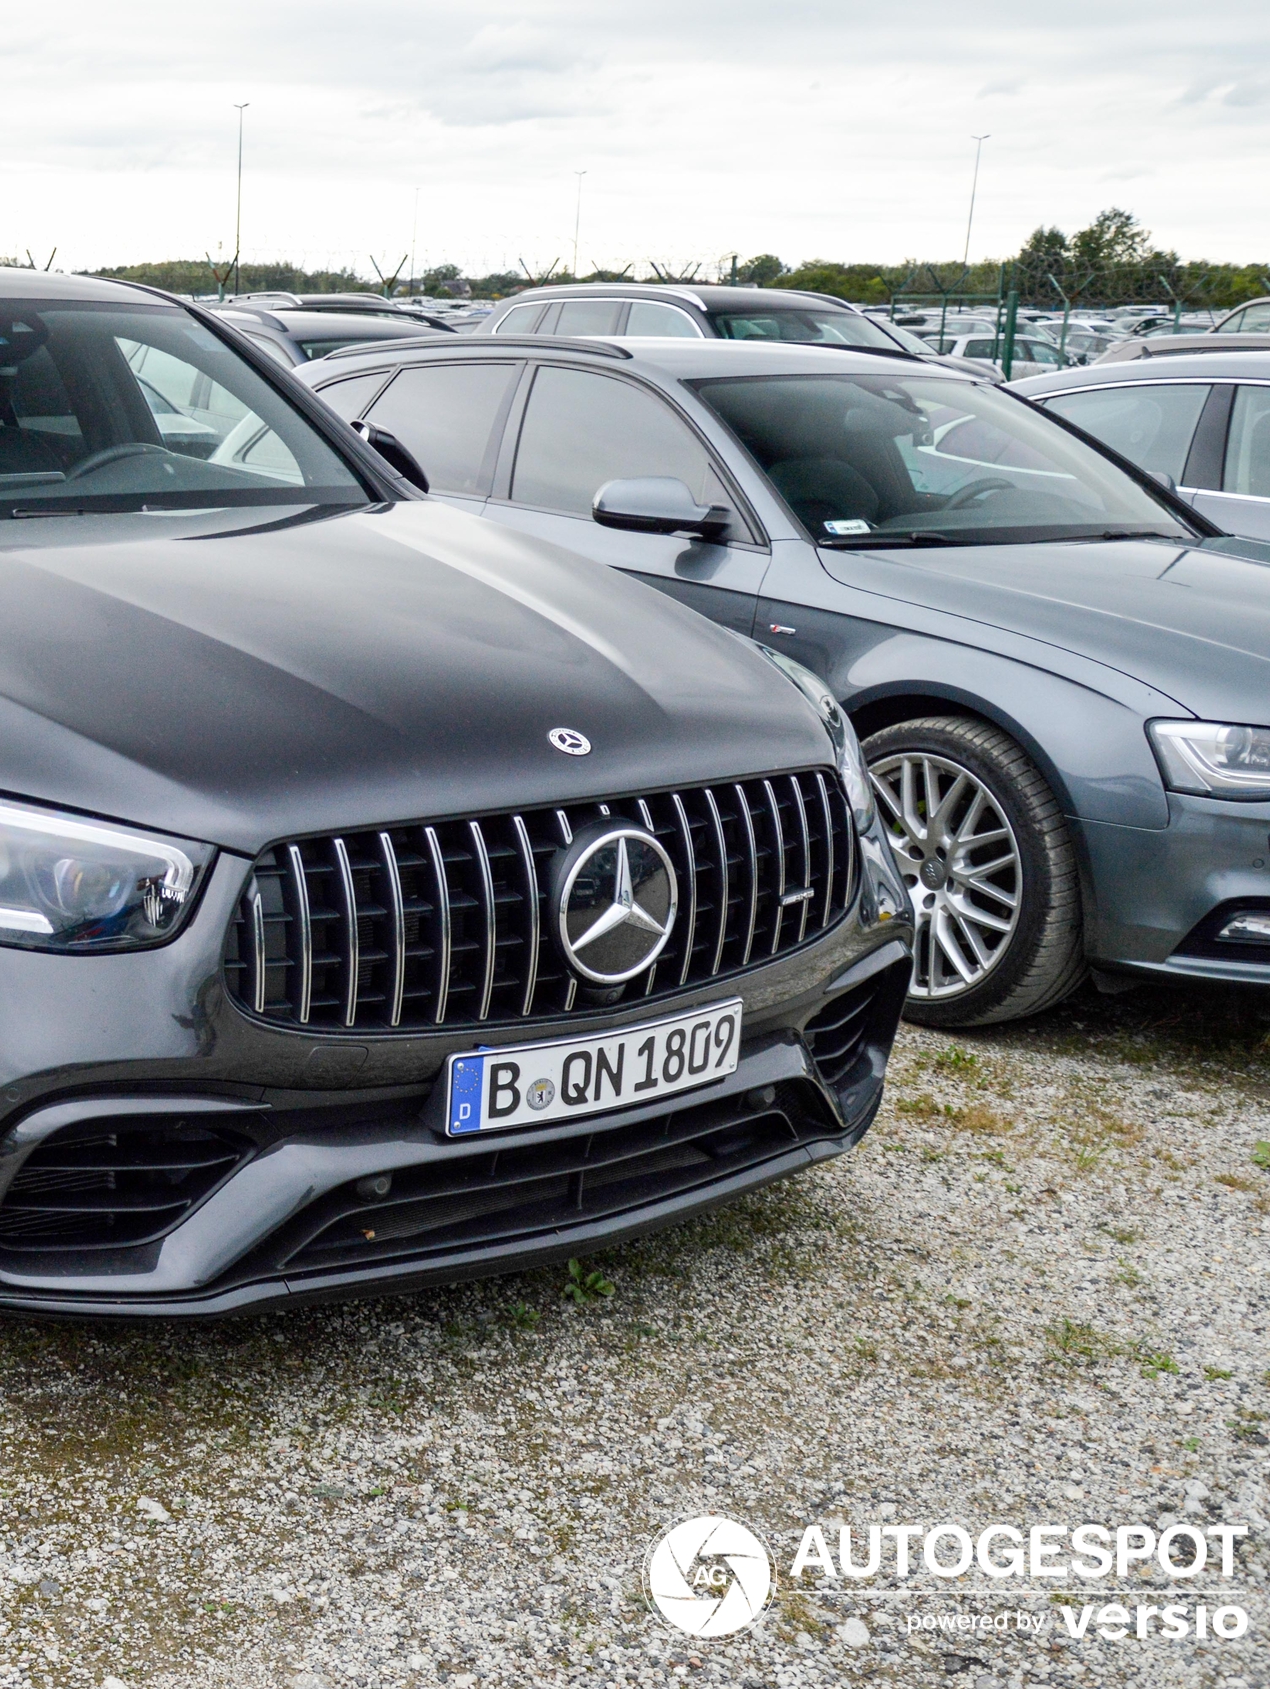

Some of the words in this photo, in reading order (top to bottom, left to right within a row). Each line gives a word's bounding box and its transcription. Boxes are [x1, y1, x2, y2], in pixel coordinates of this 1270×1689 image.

[488, 1061, 521, 1119] B
[560, 1042, 625, 1106] QN
[633, 1014, 736, 1093] 1809
[459, 1103, 471, 1120] D
